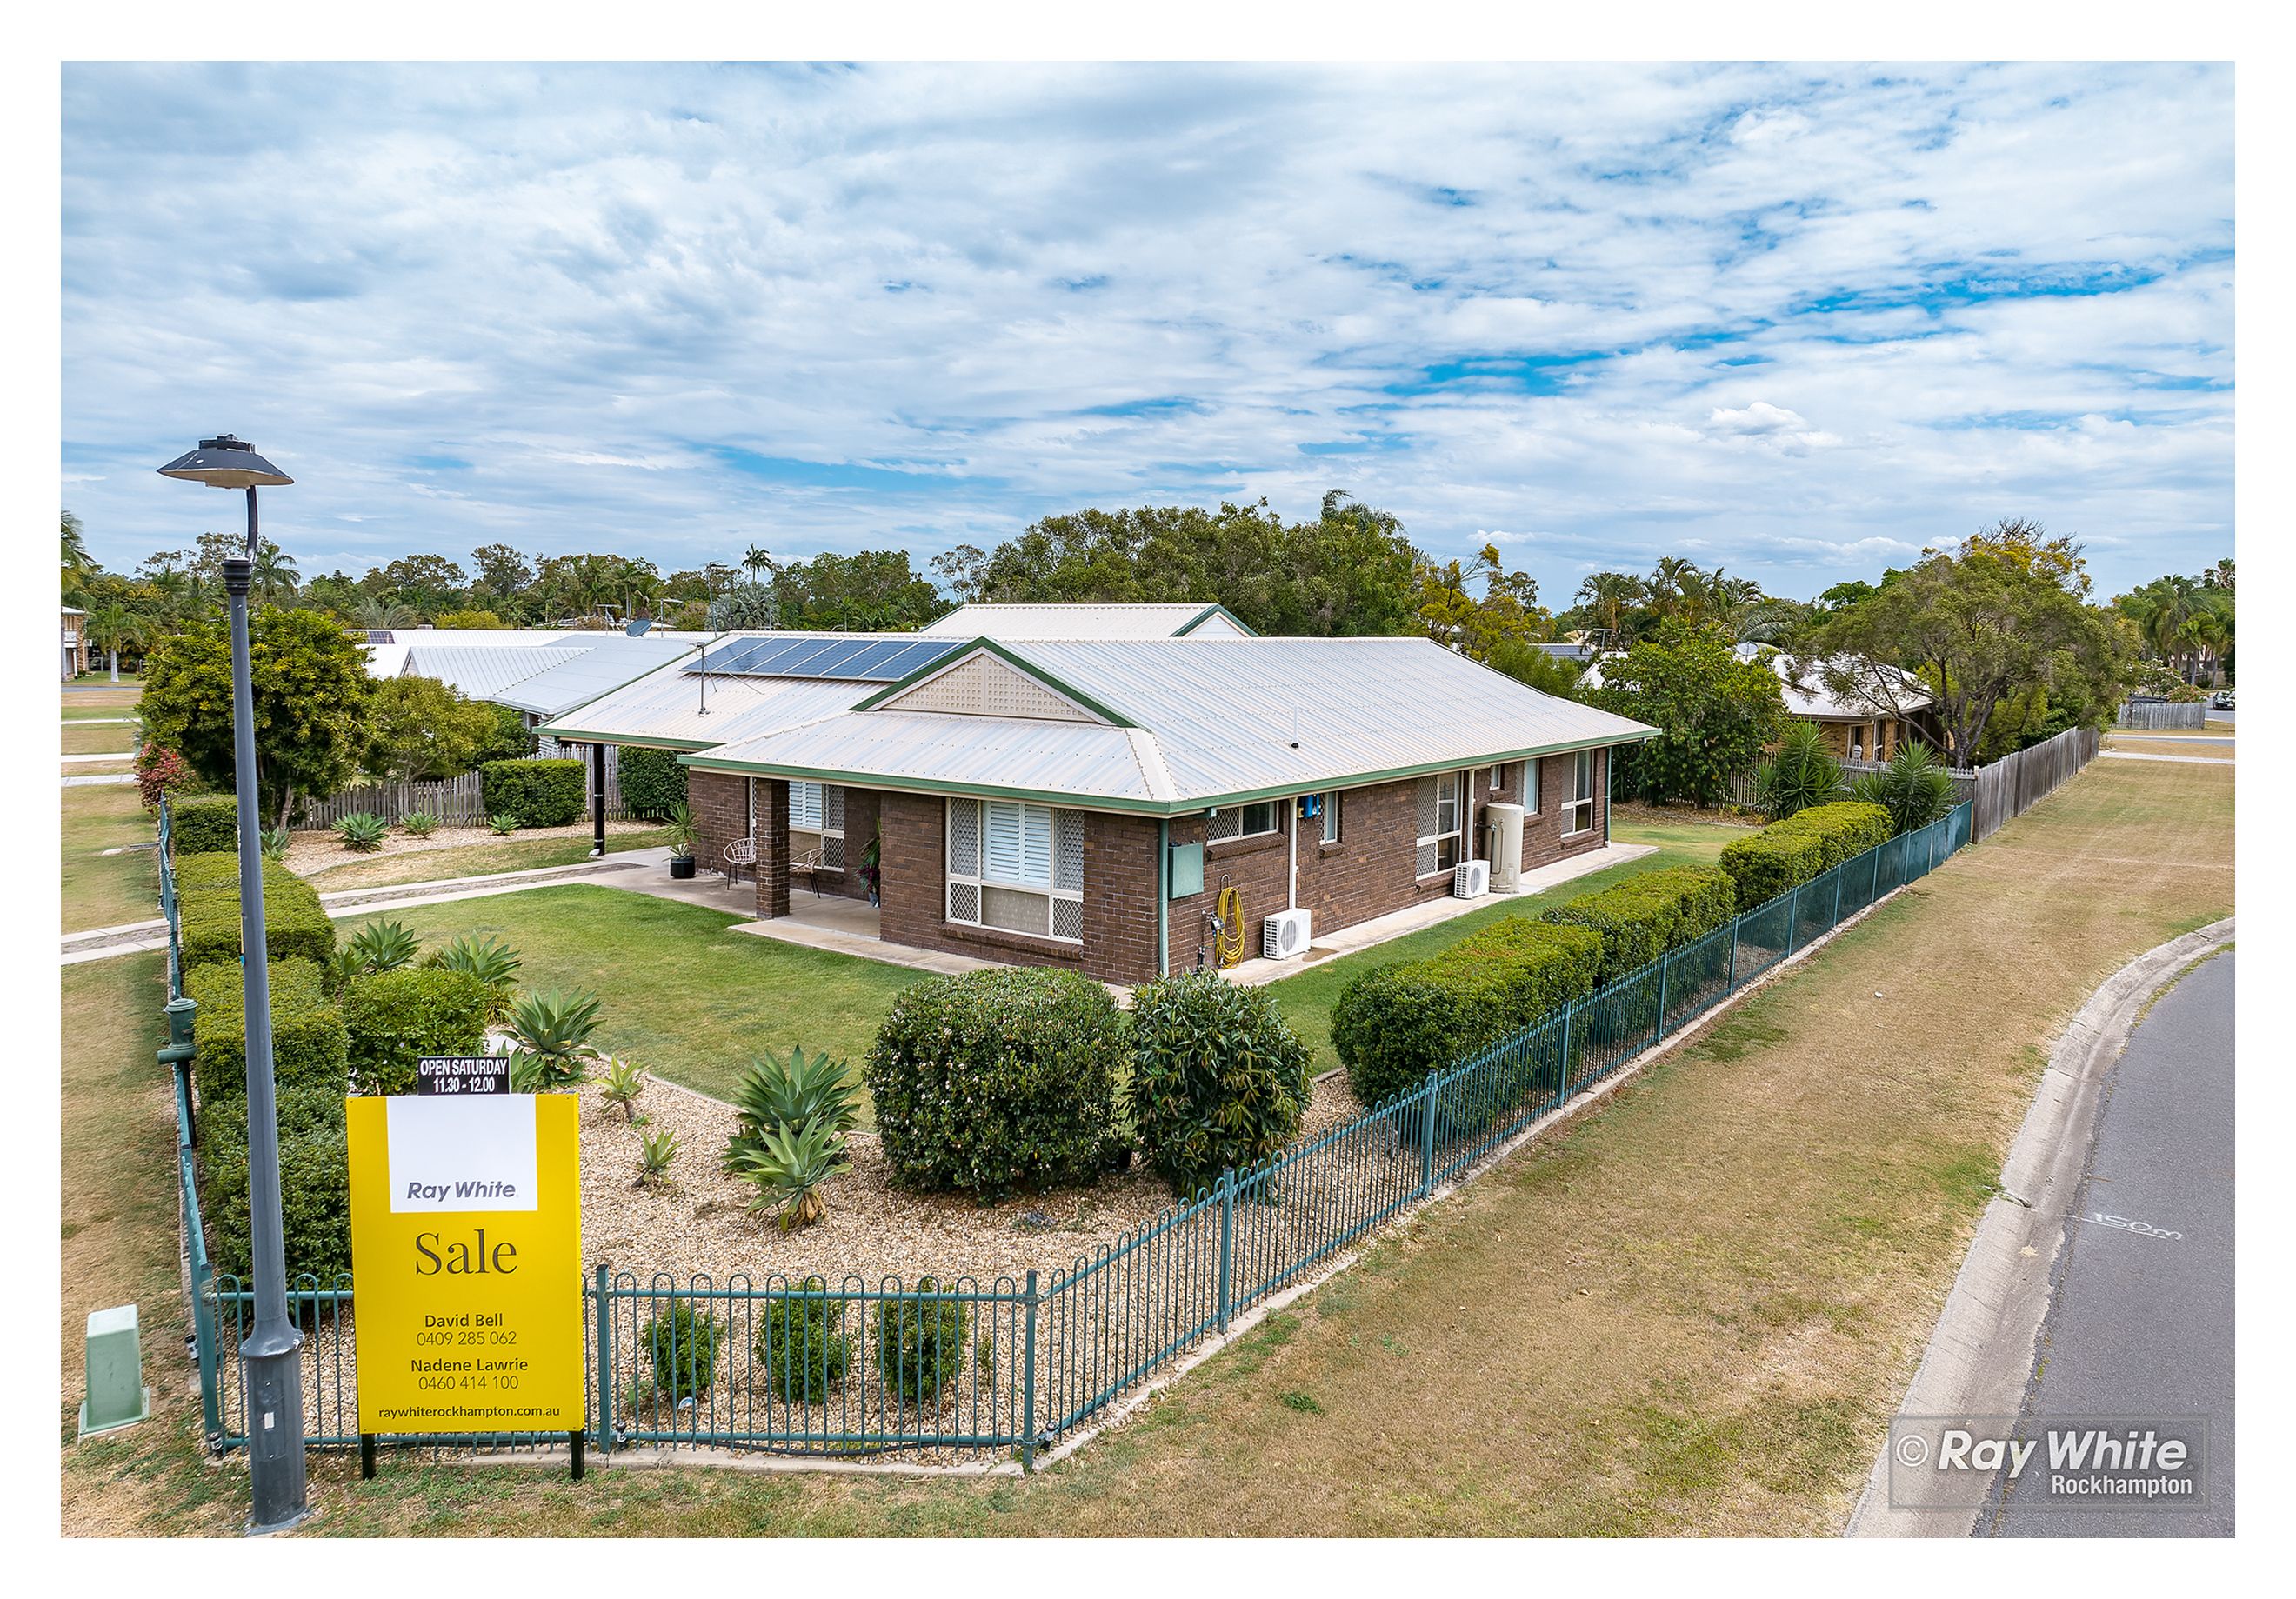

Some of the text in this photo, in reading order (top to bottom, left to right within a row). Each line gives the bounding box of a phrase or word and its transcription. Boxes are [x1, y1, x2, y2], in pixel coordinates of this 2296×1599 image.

[420, 1059, 507, 1076] OPEN SATURDAY
[433, 1076, 460, 1093] 11.30
[469, 1076, 495, 1092] 12.00
[407, 1181, 516, 1202] Ray White
[2095, 1213, 2182, 1241] 150m
[416, 1229, 517, 1276] Sale
[425, 1313, 503, 1328] David Bell
[417, 1331, 517, 1346] 0409 285 062
[411, 1357, 528, 1372] Nadene Lawrie
[418, 1376, 518, 1390] 0460 414 100
[378, 1406, 560, 1419] raywhiterockhampton.com.au
